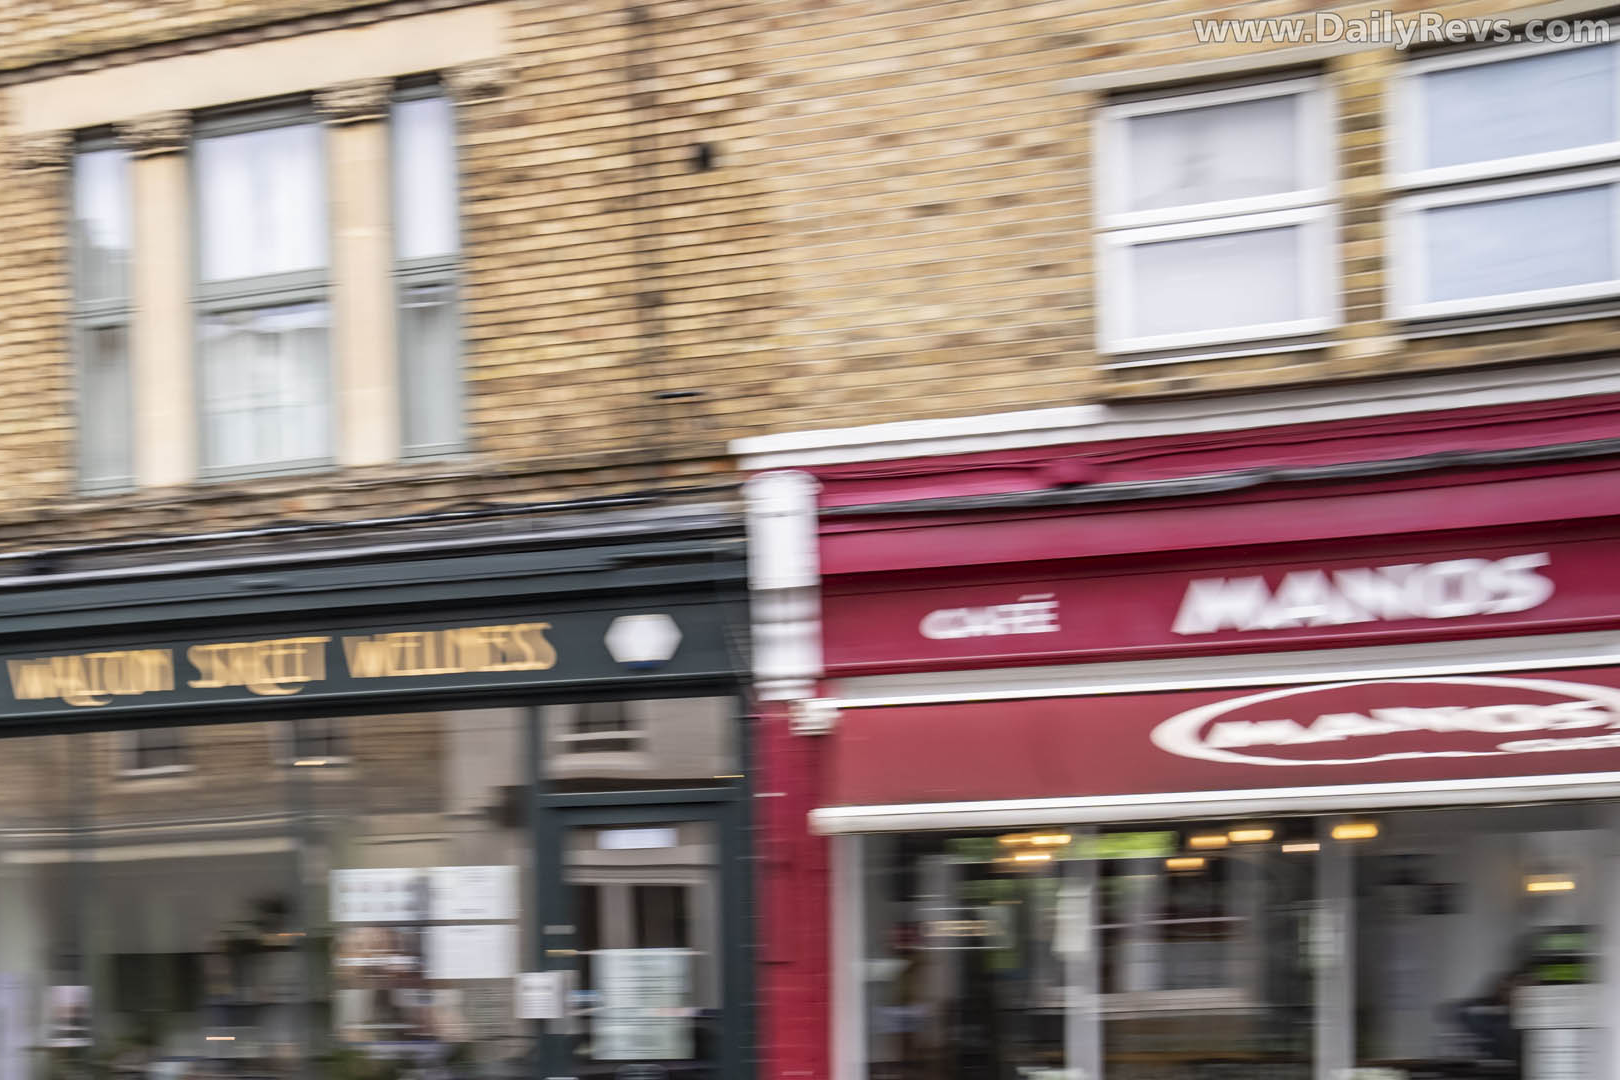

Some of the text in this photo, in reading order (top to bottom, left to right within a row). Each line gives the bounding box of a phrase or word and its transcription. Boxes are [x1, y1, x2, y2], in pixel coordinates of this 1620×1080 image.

[1170, 552, 1556, 635] MANOS
[187, 635, 332, 696] STREET
[342, 621, 558, 679] WELLNESS
